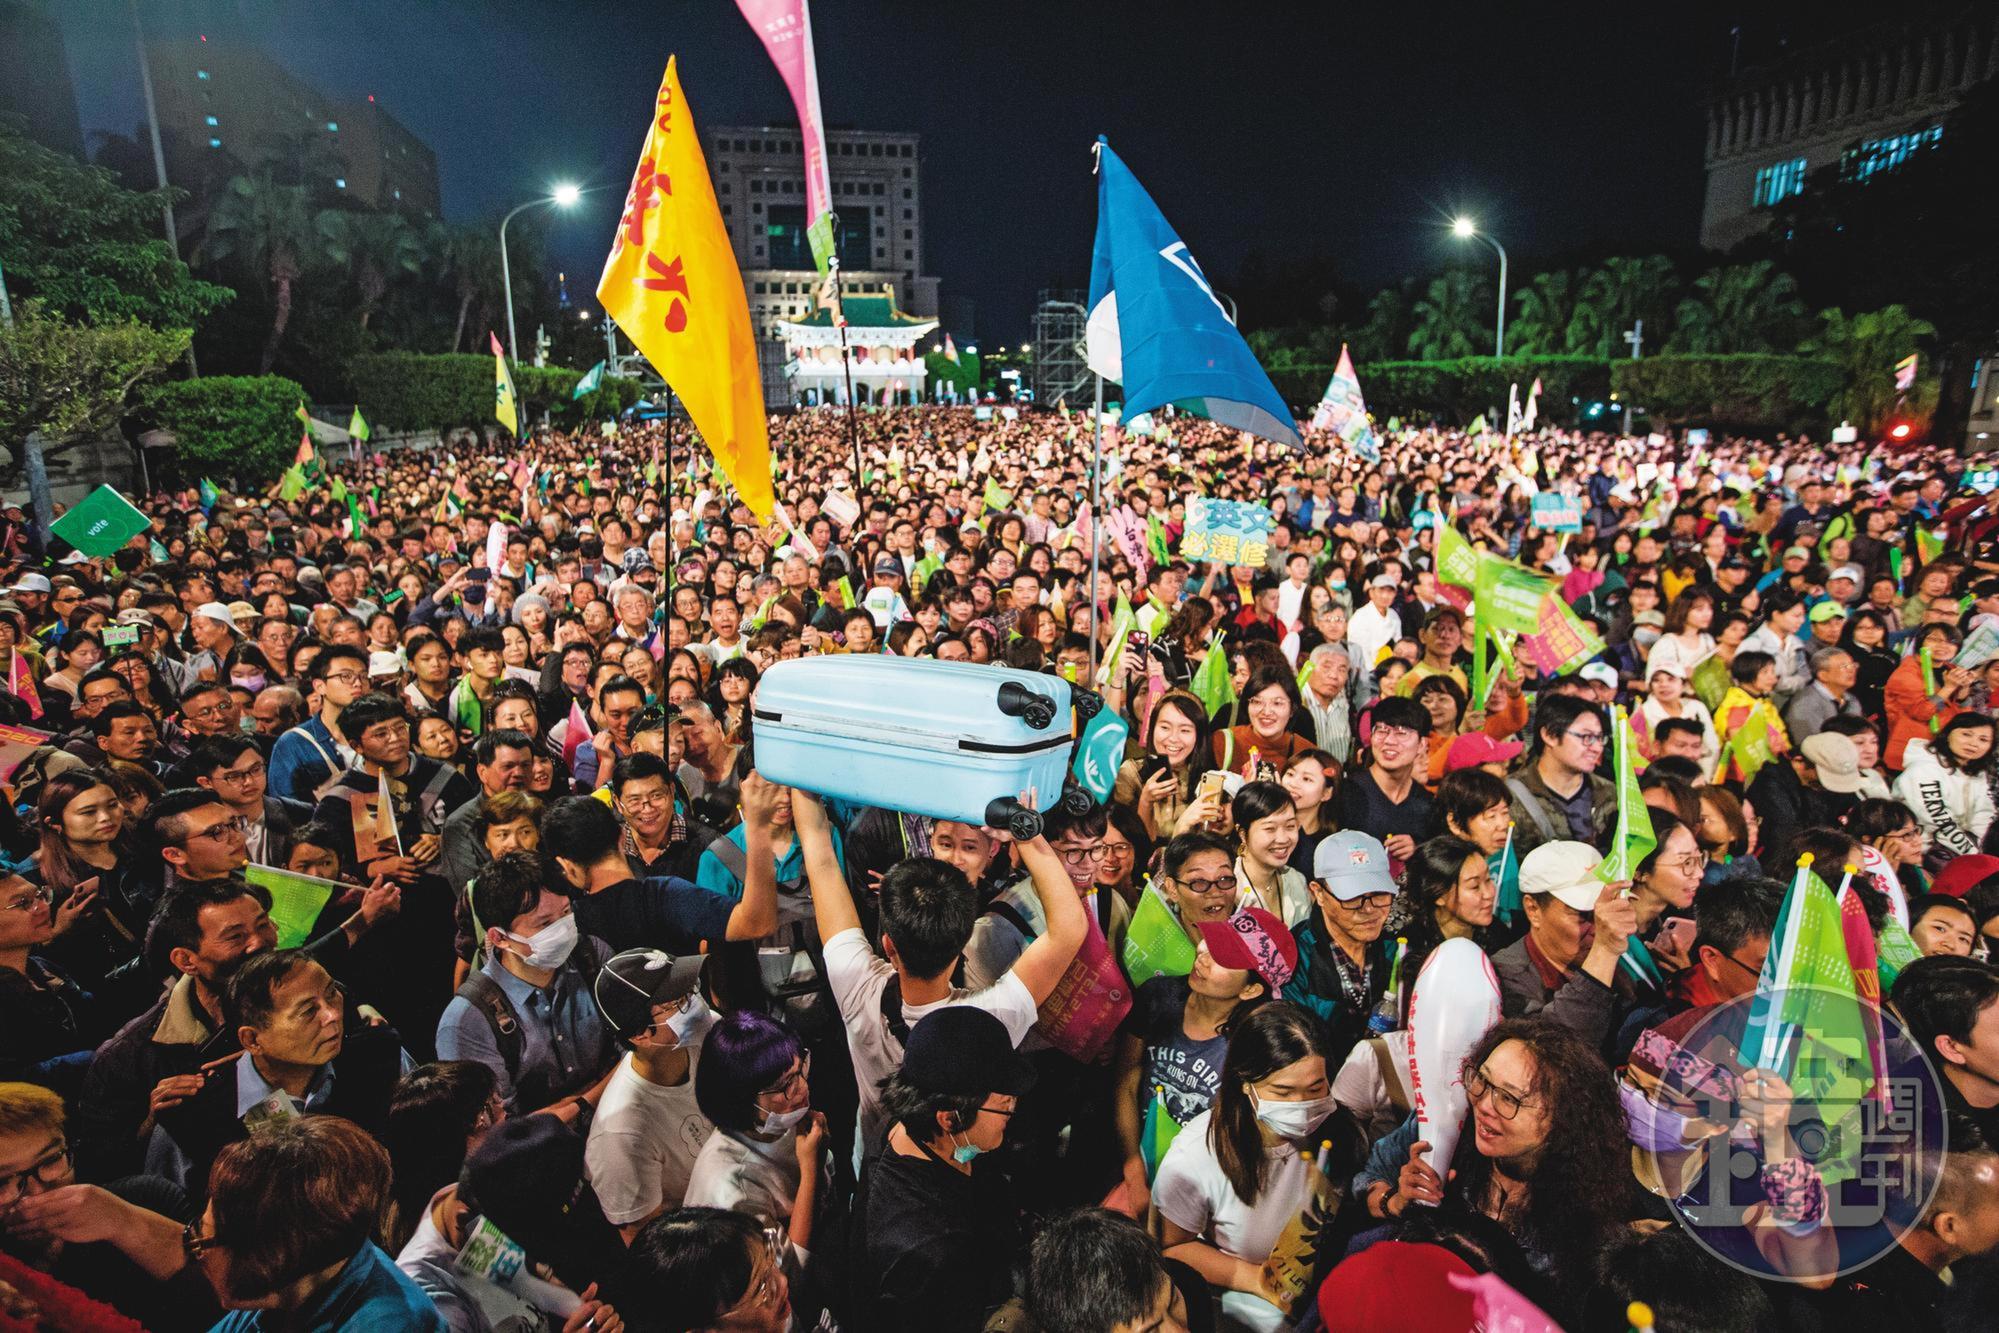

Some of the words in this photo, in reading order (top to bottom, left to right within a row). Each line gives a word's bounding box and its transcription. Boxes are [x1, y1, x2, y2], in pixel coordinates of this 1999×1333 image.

[88, 519, 109, 536] vote
[1207, 501, 1275, 534] 英文
[1179, 531, 1269, 567] 必選修
[1147, 1046, 1186, 1064] THIS
[1192, 1058, 1222, 1095] GIRL
[1166, 1064, 1187, 1083] RUNS
[1186, 1074, 1199, 1089] ON
